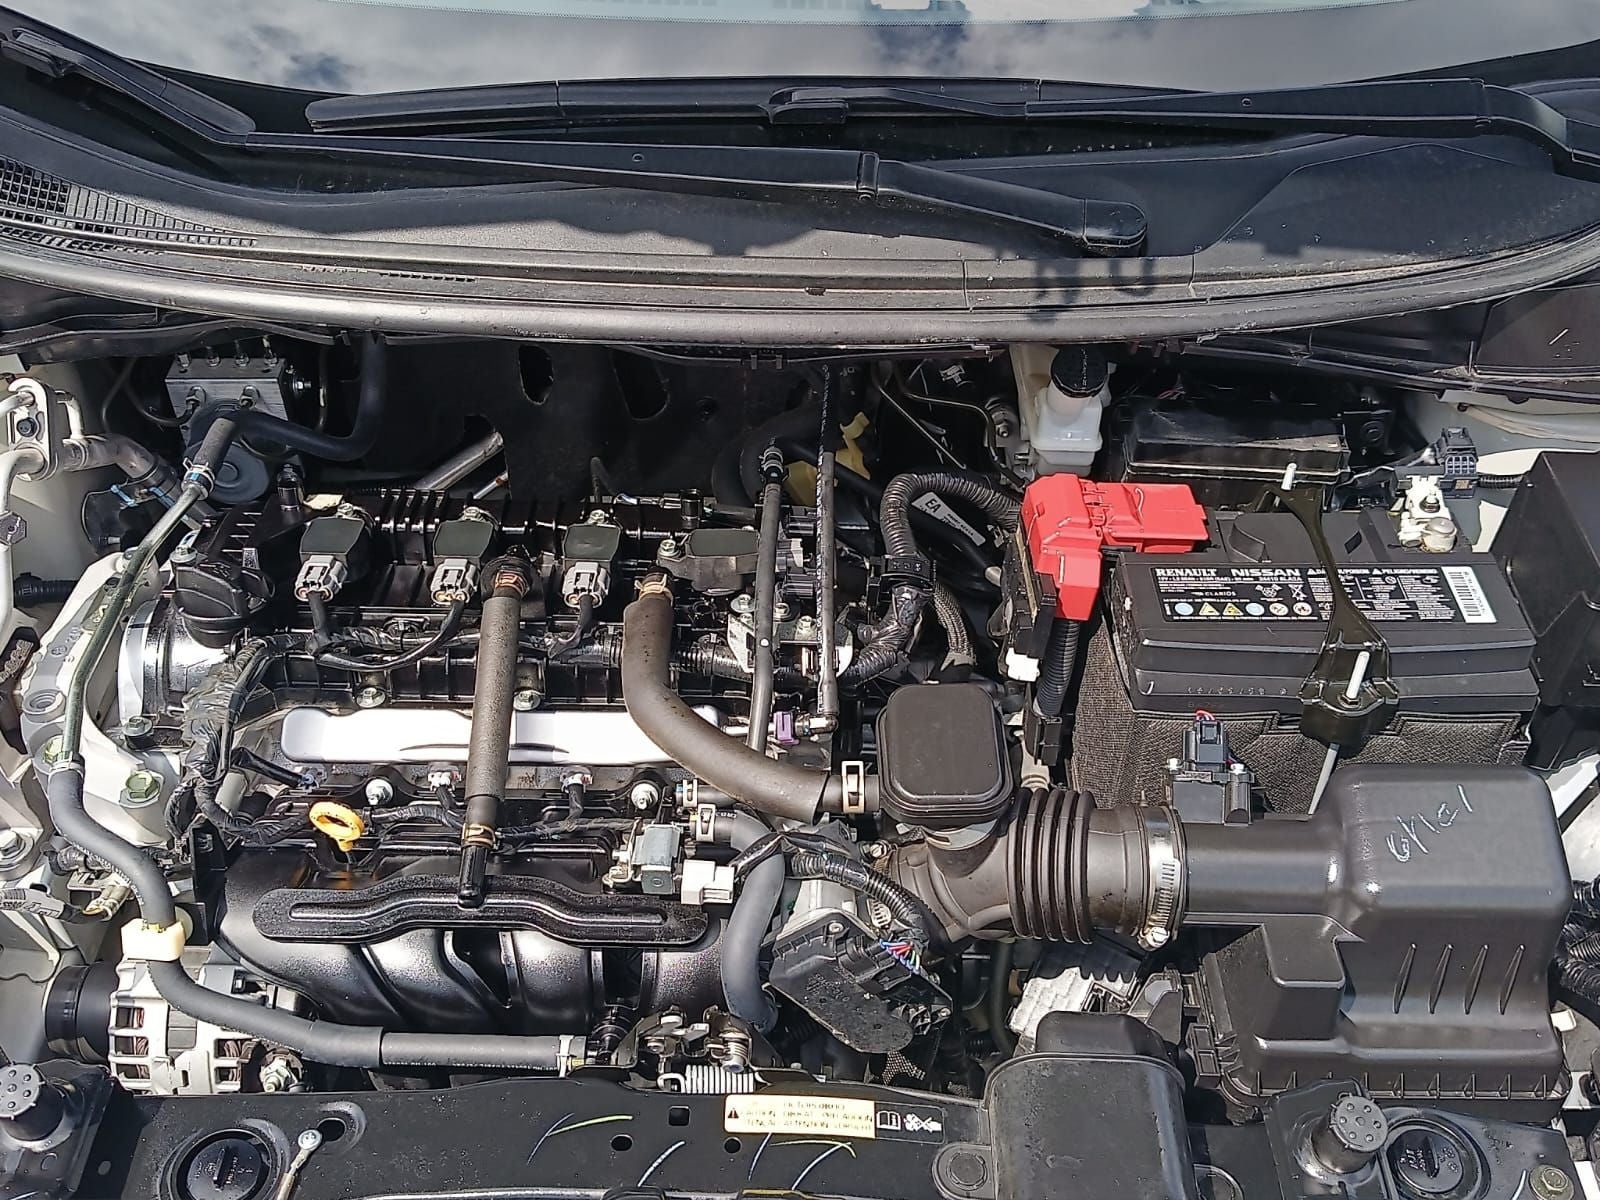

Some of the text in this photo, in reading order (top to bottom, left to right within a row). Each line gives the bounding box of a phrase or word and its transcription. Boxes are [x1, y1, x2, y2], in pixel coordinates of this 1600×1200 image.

[925, 498, 941, 513] EA
[1155, 568, 1301, 577] RENAULT NISSAN
